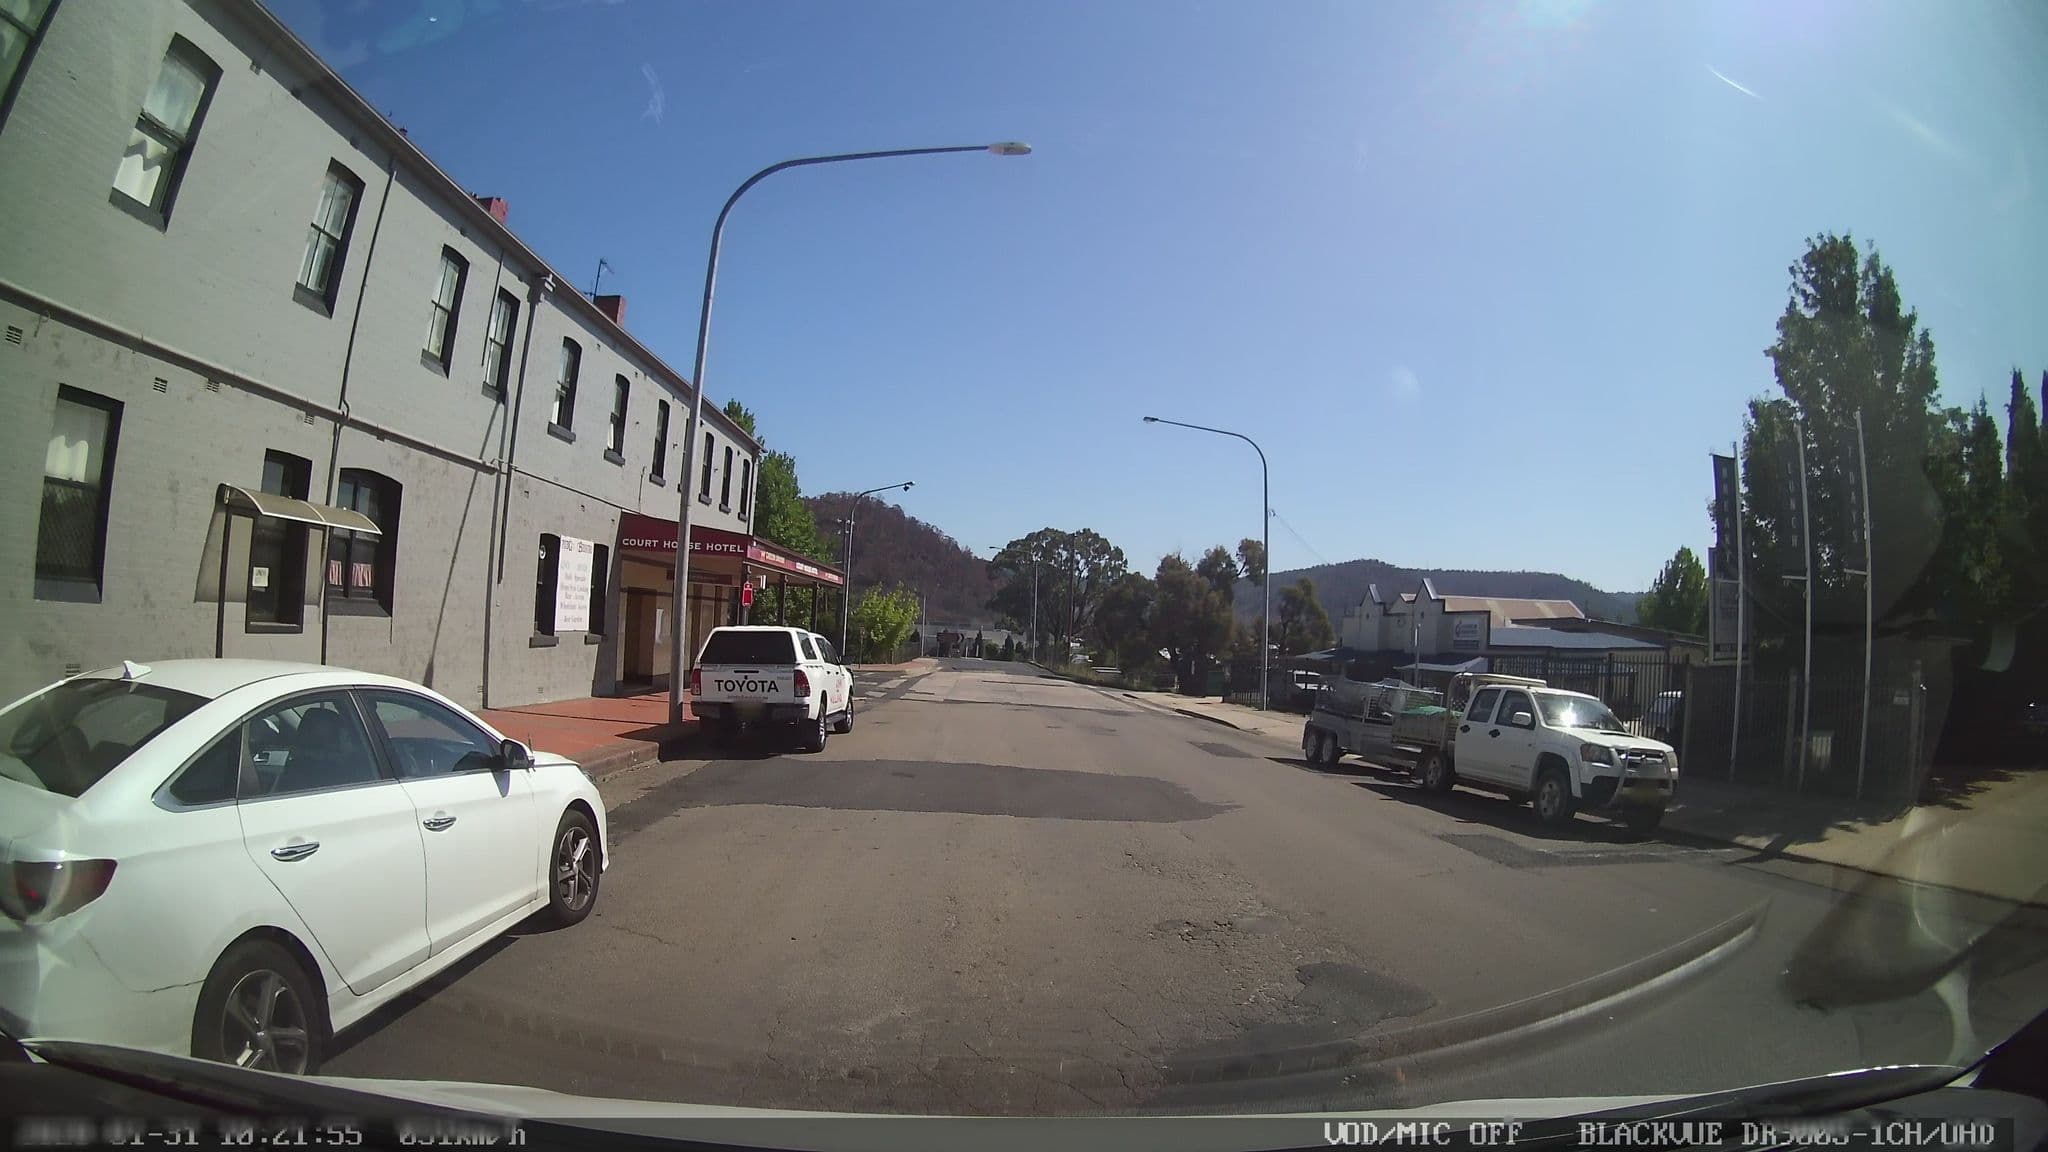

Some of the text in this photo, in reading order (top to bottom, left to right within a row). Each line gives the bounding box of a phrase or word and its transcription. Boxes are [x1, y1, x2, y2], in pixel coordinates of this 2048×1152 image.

[622, 538, 744, 552] COURT HOSE HOTEL
[714, 679, 779, 693] TOYOTA
